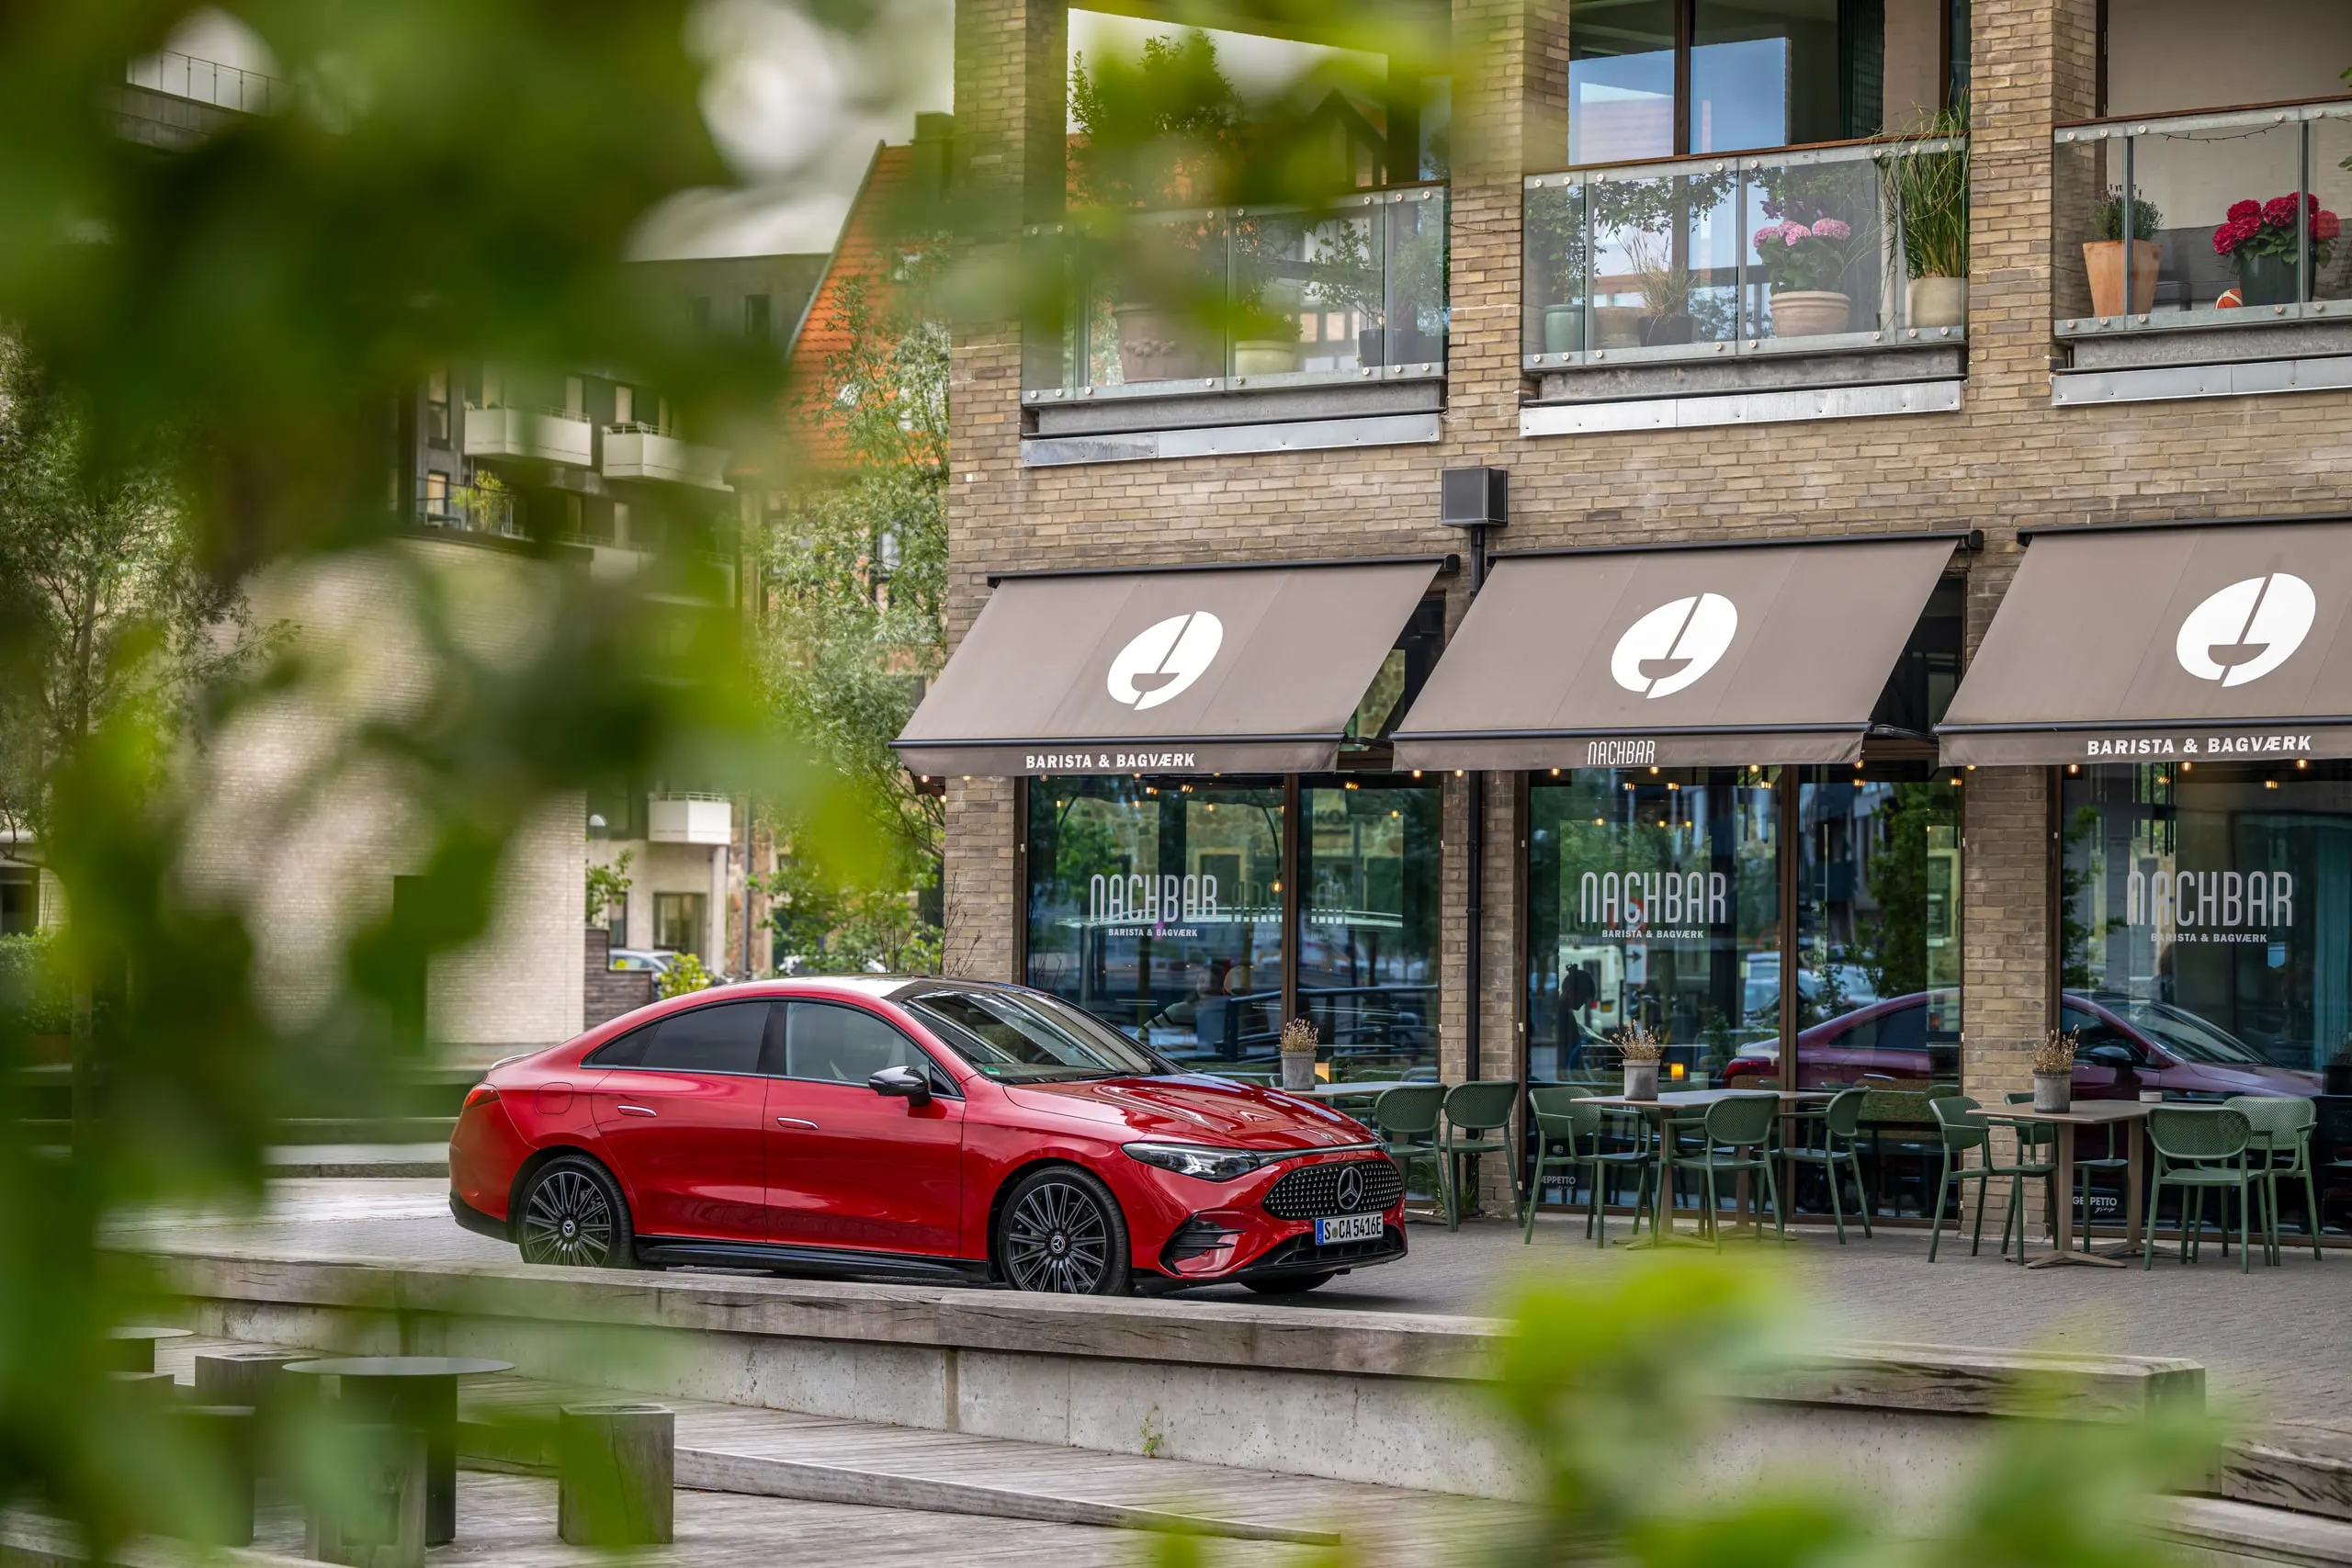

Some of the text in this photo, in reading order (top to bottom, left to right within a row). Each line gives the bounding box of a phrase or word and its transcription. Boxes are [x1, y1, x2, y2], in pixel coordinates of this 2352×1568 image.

[1587, 740, 1656, 765] NACHBAR
[2086, 735, 2312, 756] BARISTA & BAGVÆRK
[1025, 752, 1195, 769] BARISTA & BAGVÆRK
[1090, 874, 1218, 924] NACHBAR
[1580, 871, 1726, 924] NACHBAR
[2126, 870, 2293, 927] NACHBAR
[1108, 928, 1198, 937] BARISTA & BAGVÆRK
[1601, 930, 1704, 939] BARISTA & BAGVÆRK
[2151, 932, 2267, 943] BARISTA & BAGVÆRK
[1541, 1176, 1576, 1184] EPPETTO
[2073, 1197, 2117, 1206] GEPETTO
[1324, 1221, 1331, 1240] S
[1339, 1219, 1351, 1239] CA
